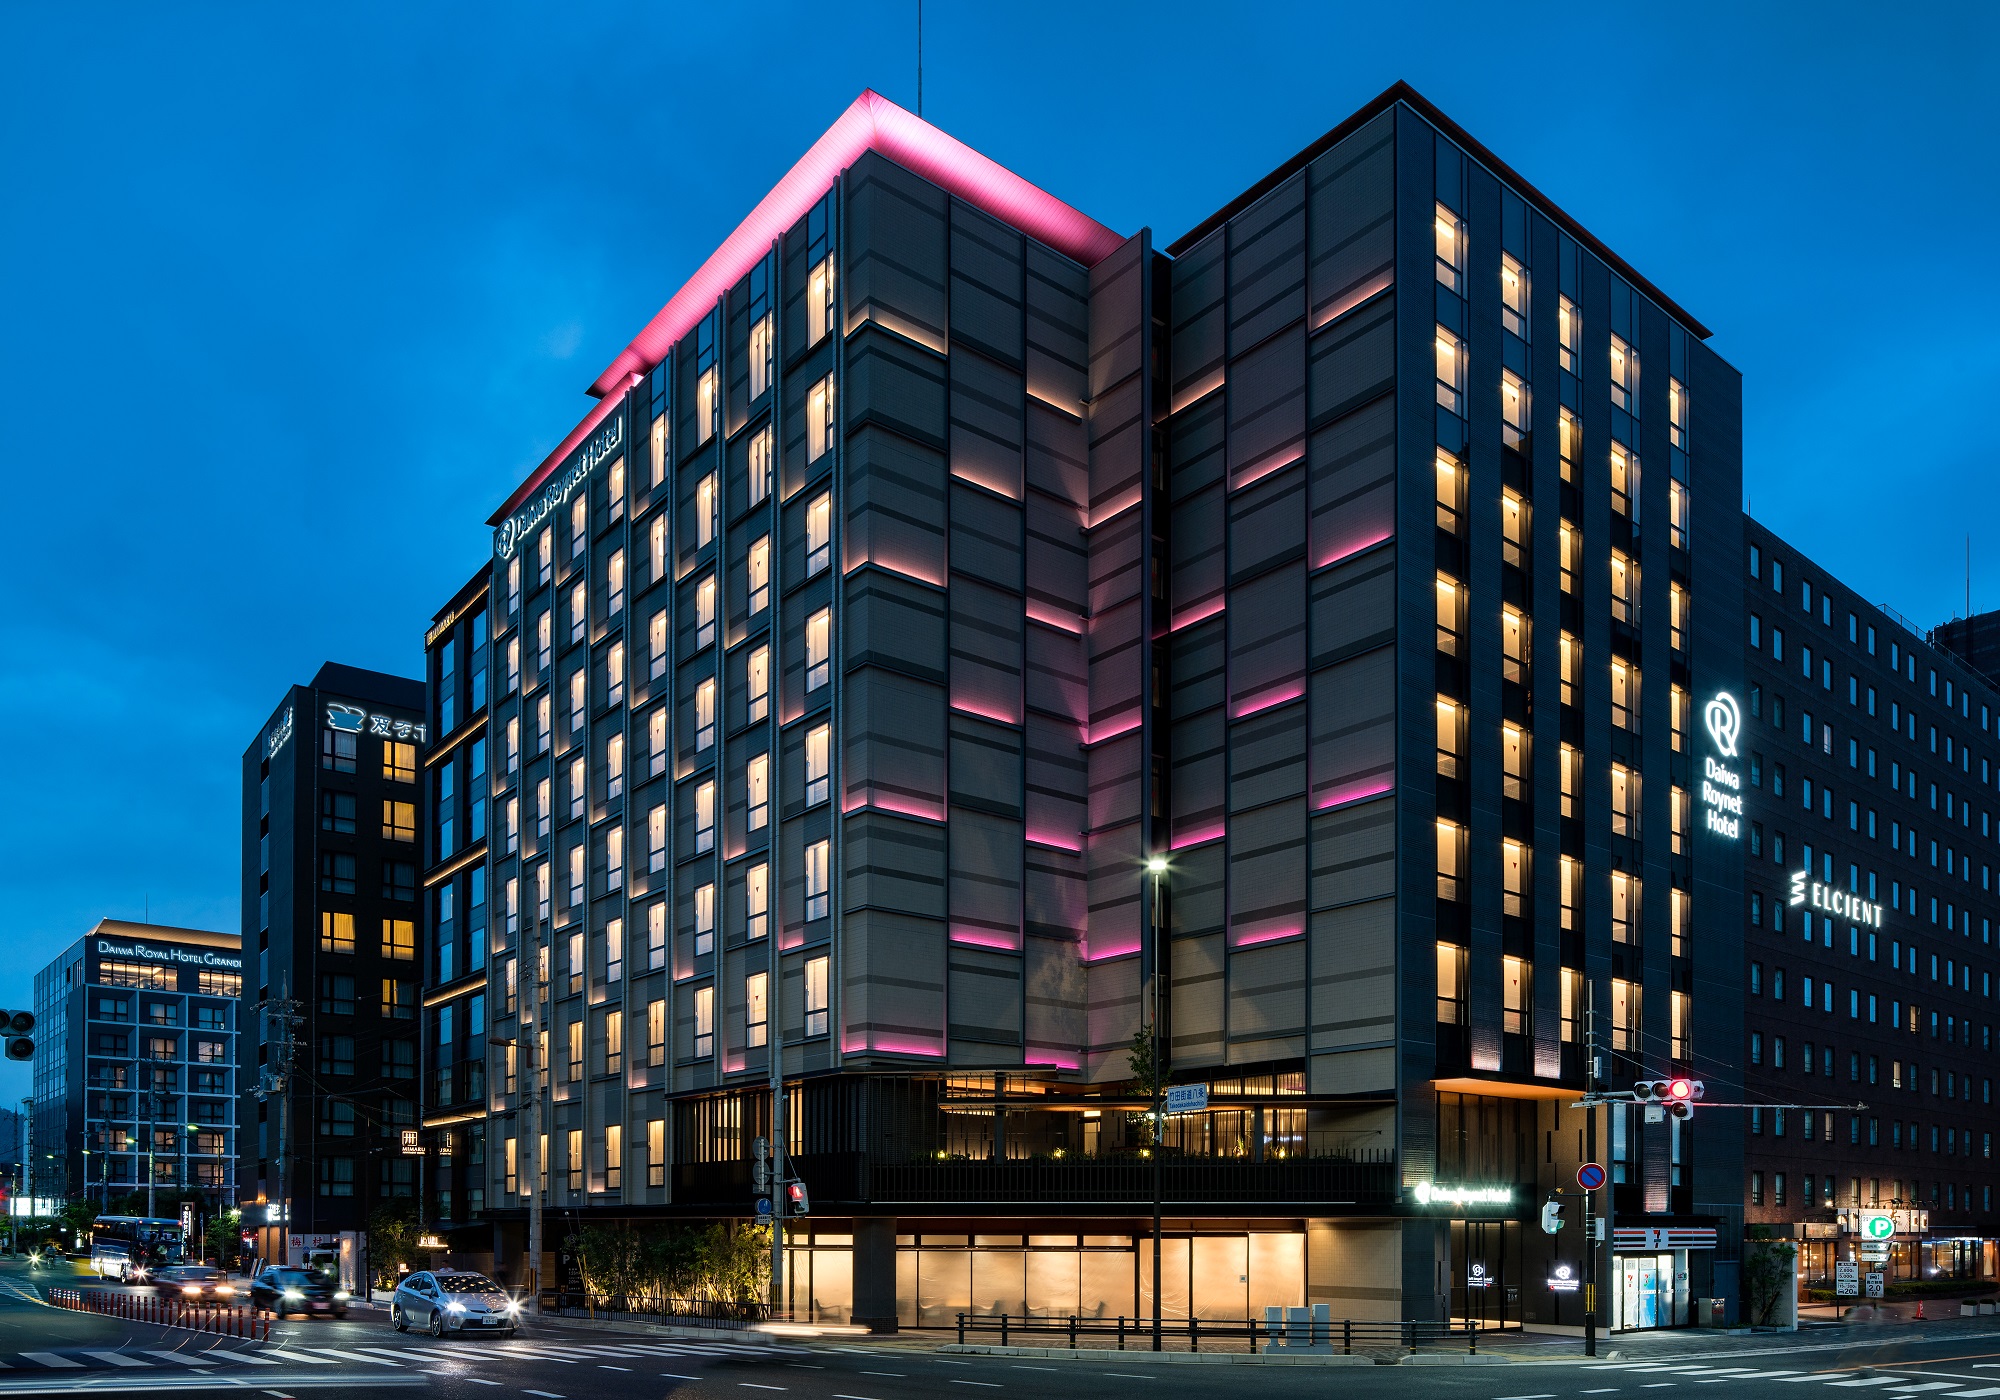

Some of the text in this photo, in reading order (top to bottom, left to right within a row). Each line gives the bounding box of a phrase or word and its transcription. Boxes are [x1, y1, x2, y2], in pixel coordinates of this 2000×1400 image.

[514, 497, 546, 541] Daiwa
[545, 455, 587, 510] Roynet
[586, 416, 622, 471] Hotel
[1705, 757, 1740, 790] Daiwa
[1703, 781, 1742, 815] Roynet
[1707, 809, 1739, 839] Hotel
[1812, 882, 1882, 928] ELCIENT
[204, 952, 242, 968] GRAND
[1874, 1219, 1889, 1236] P
[562, 1254, 570, 1265] P
[1868, 1284, 1881, 1292] 2.0
